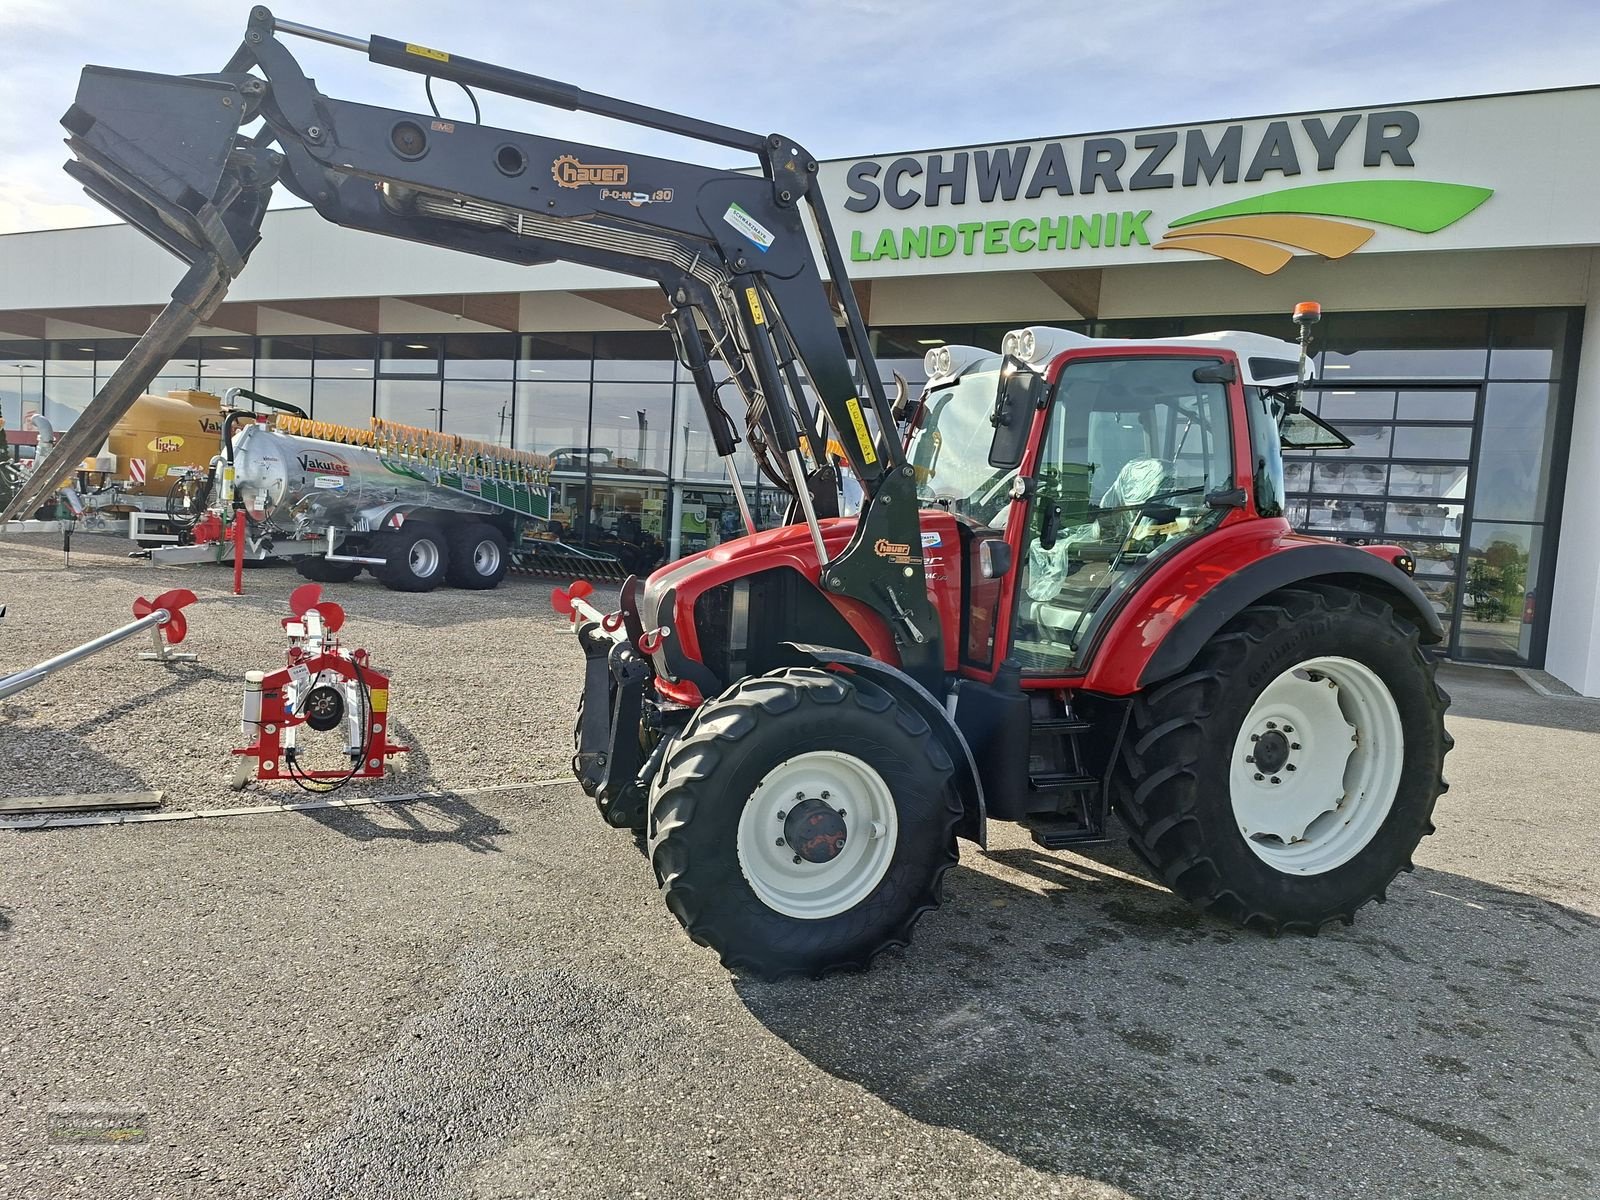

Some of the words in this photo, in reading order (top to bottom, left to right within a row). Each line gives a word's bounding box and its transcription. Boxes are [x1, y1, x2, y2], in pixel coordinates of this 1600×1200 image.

[844, 110, 1420, 212] SCHWARZMAYR
[732, 210, 767, 239] SCHWARZMAYR
[850, 209, 1154, 262] LANDTECHNIK
[155, 437, 181, 453] light
[297, 454, 350, 473] Vakutec
